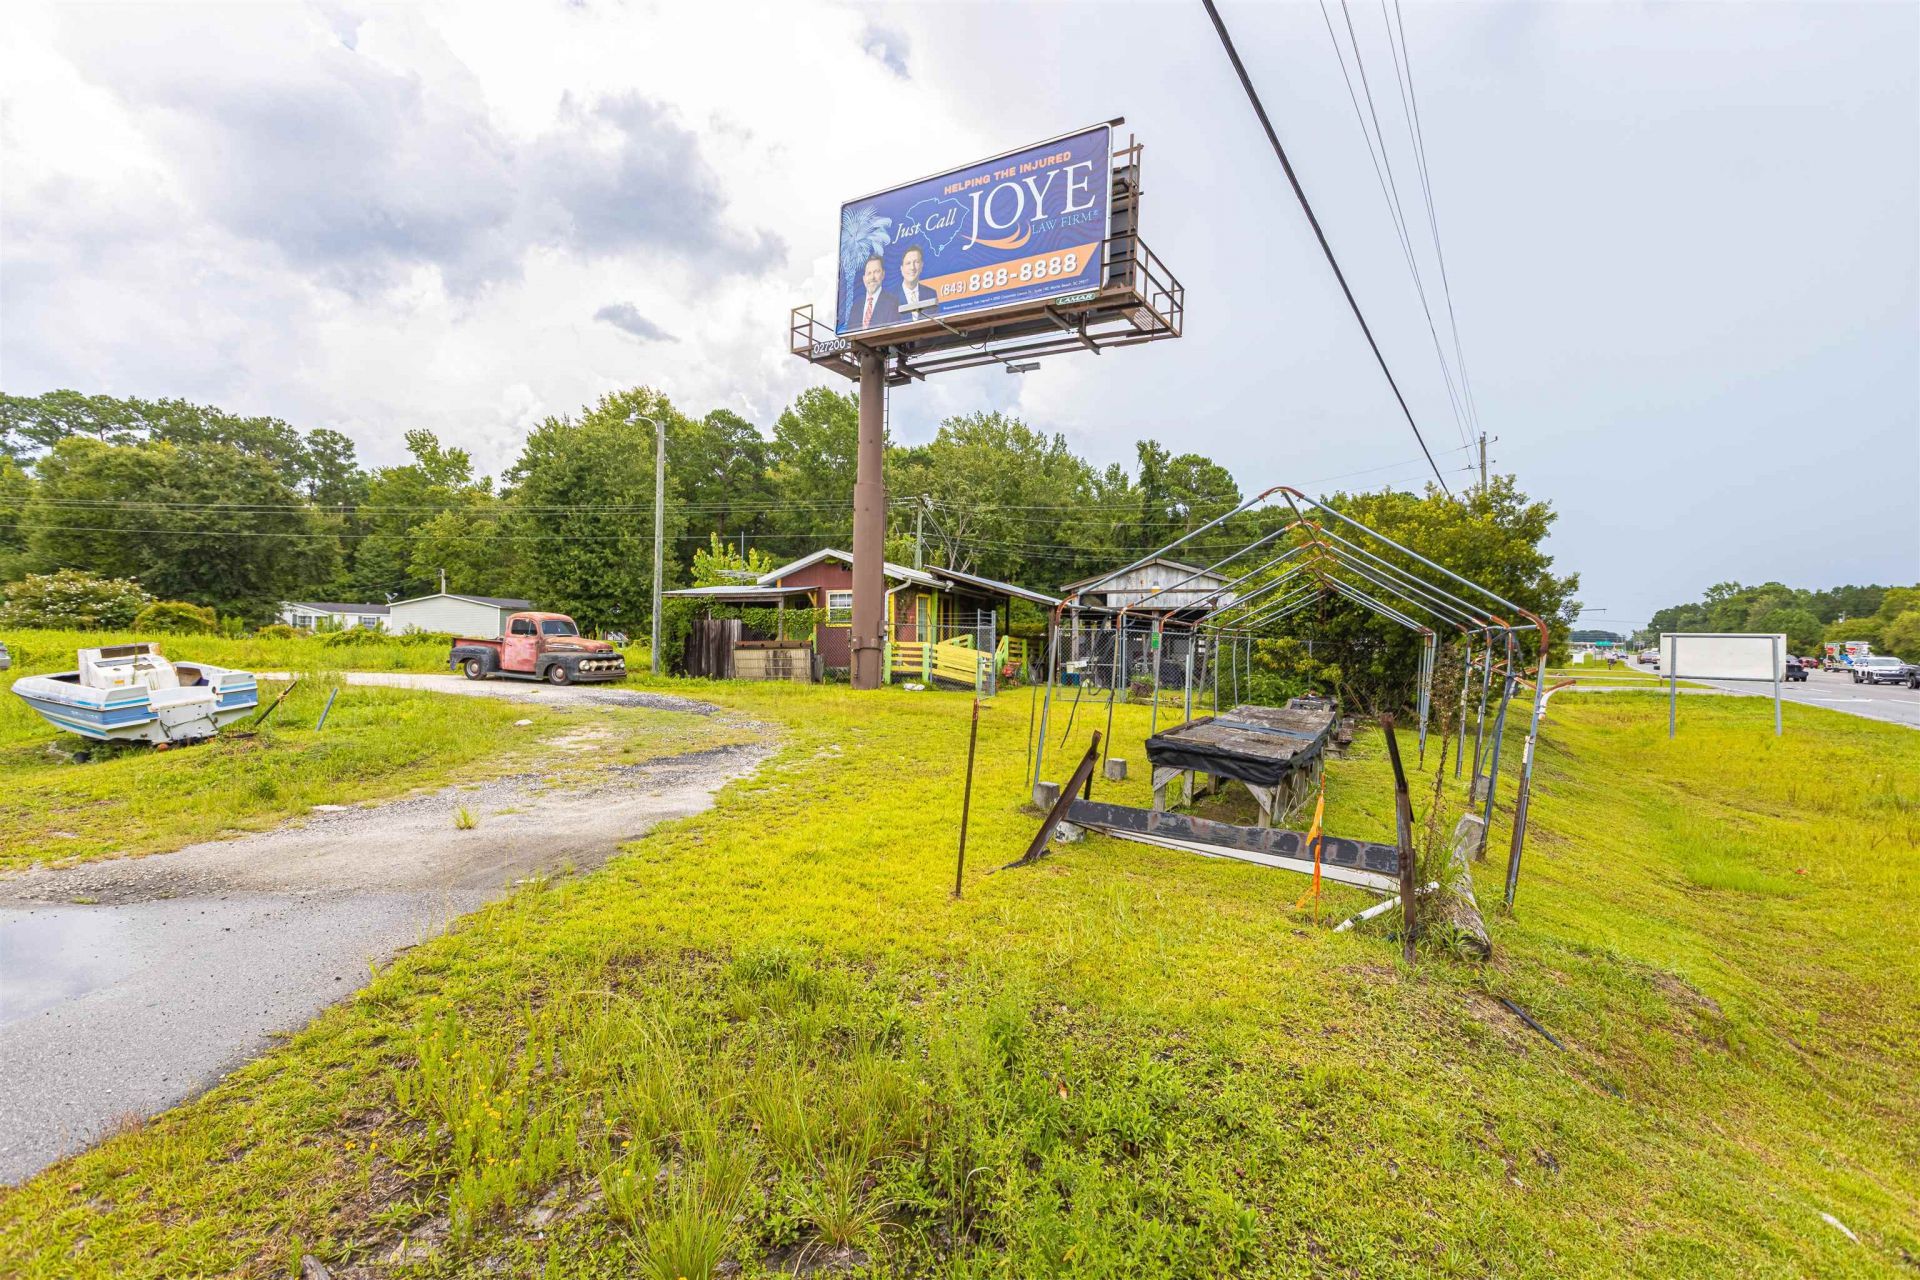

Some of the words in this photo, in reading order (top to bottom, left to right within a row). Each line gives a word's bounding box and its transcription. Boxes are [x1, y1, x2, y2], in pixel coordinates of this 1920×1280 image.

[944, 175, 991, 195] HELPING
[994, 167, 1017, 181] THE
[1020, 151, 1072, 174] INJURED
[962, 160, 1096, 251] JOYE
[892, 222, 922, 245] Just
[926, 208, 957, 231] Call
[1031, 218, 1057, 235] LAW
[940, 280, 967, 297] (843)
[968, 252, 1078, 292] 888-8888
[1058, 293, 1094, 305] LAMAR
[813, 338, 846, 354] 027200
